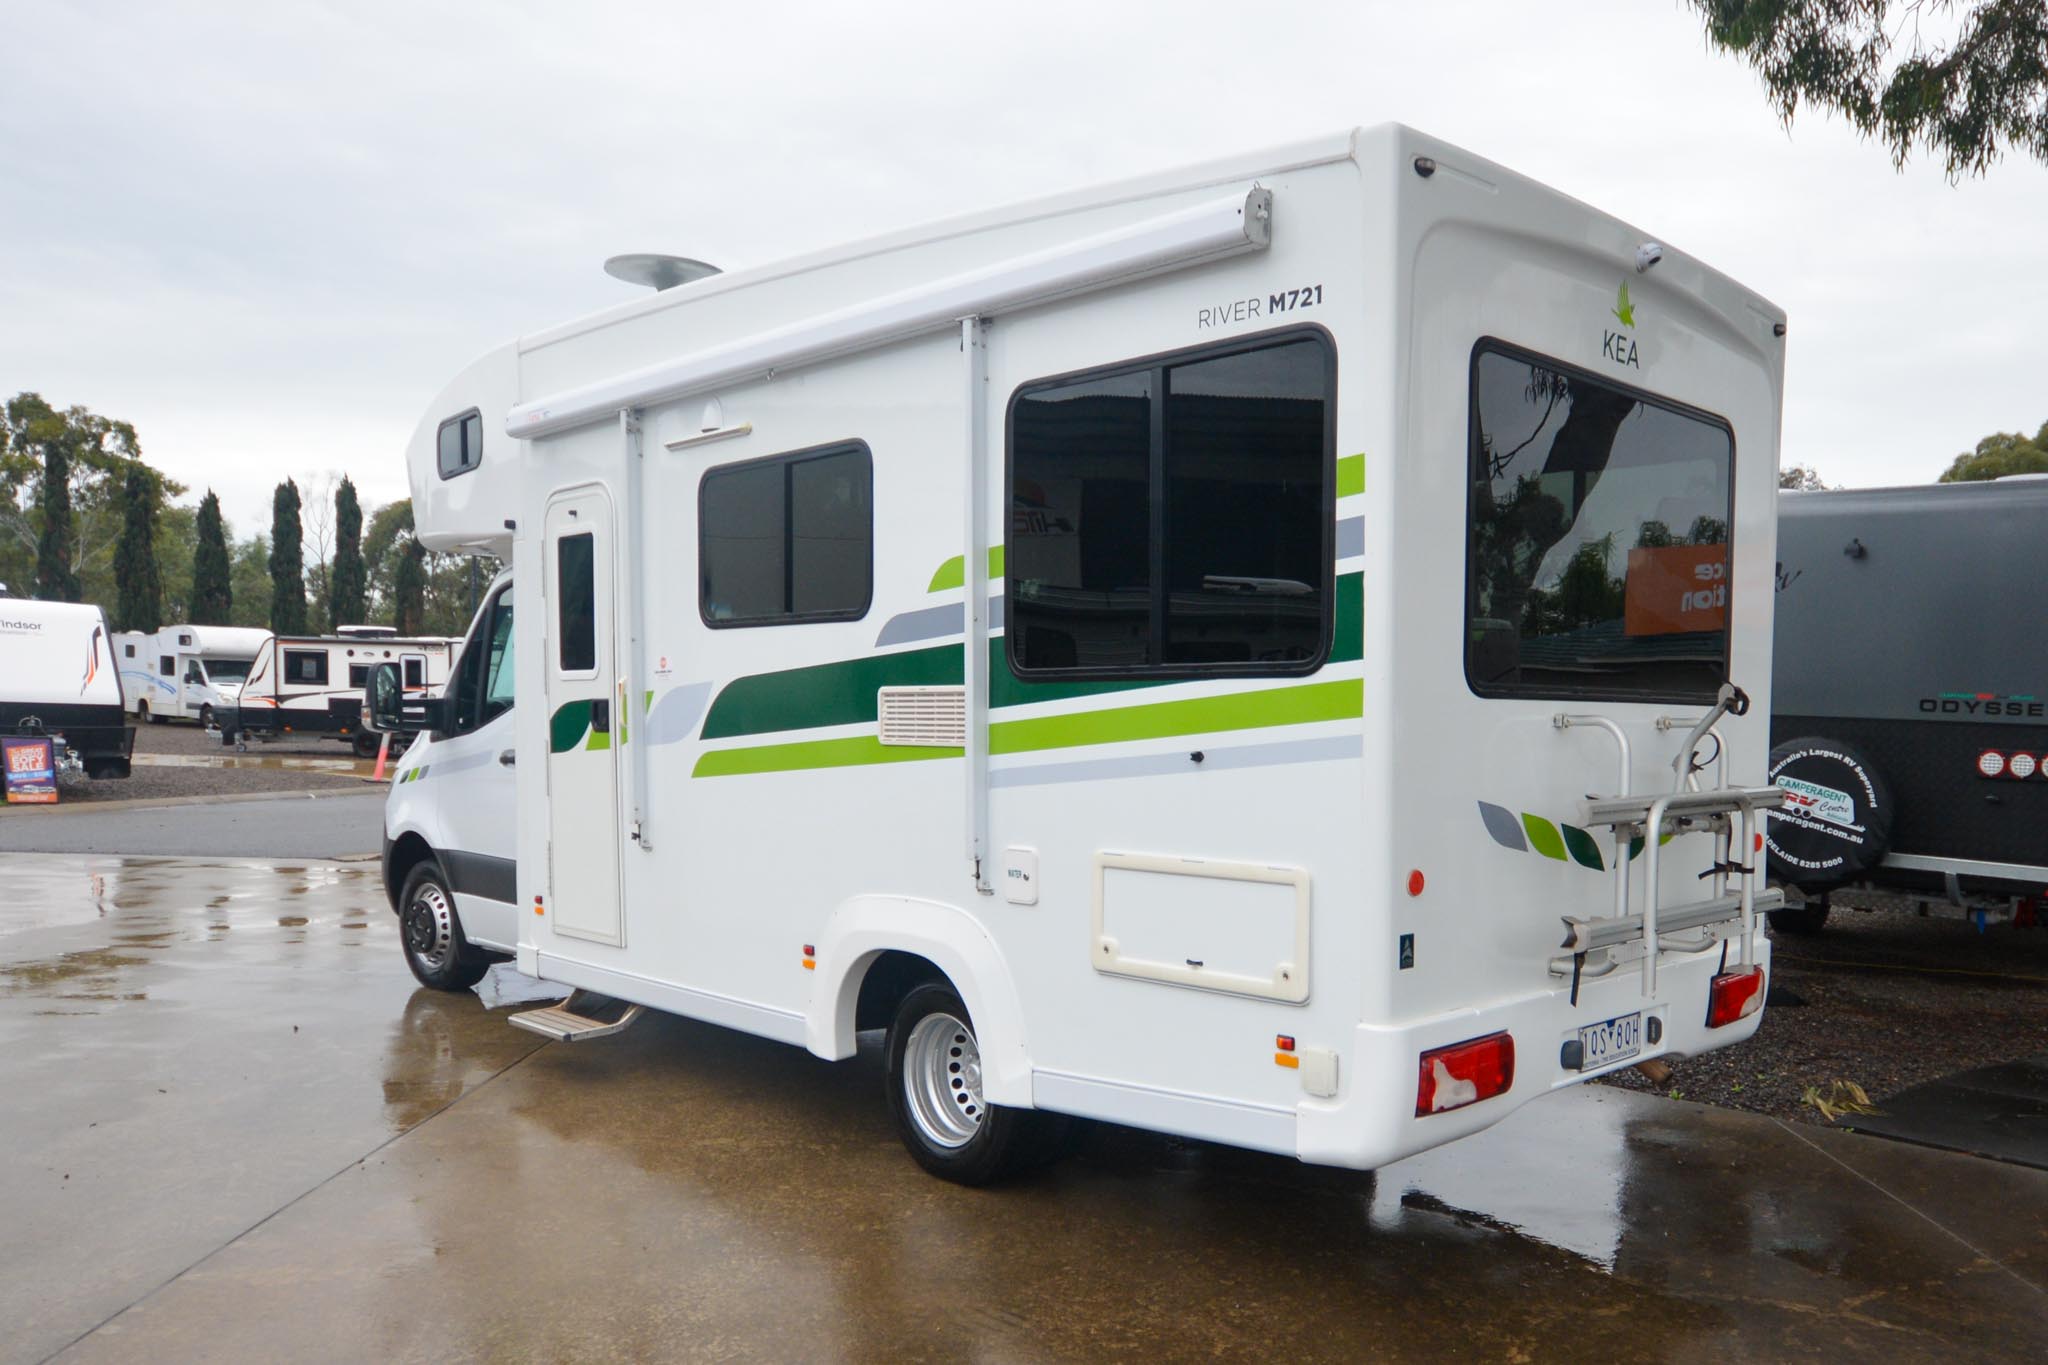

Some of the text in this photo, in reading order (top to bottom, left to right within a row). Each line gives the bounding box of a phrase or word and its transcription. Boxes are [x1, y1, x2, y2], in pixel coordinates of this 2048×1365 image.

[1198, 284, 1323, 329] RIVER M721
[1603, 329, 1640, 369] KEA
[0, 619, 42, 630] indsor
[1919, 699, 2044, 717] ODYSSE
[1769, 748, 1878, 808] Australia's Largest RV Superyard
[1777, 777, 1847, 803] CAMPERAGENT
[1820, 801, 1849, 814] Centre
[1765, 808, 1863, 844] amperagent.com.au
[1822, 856, 1843, 868] 5000
